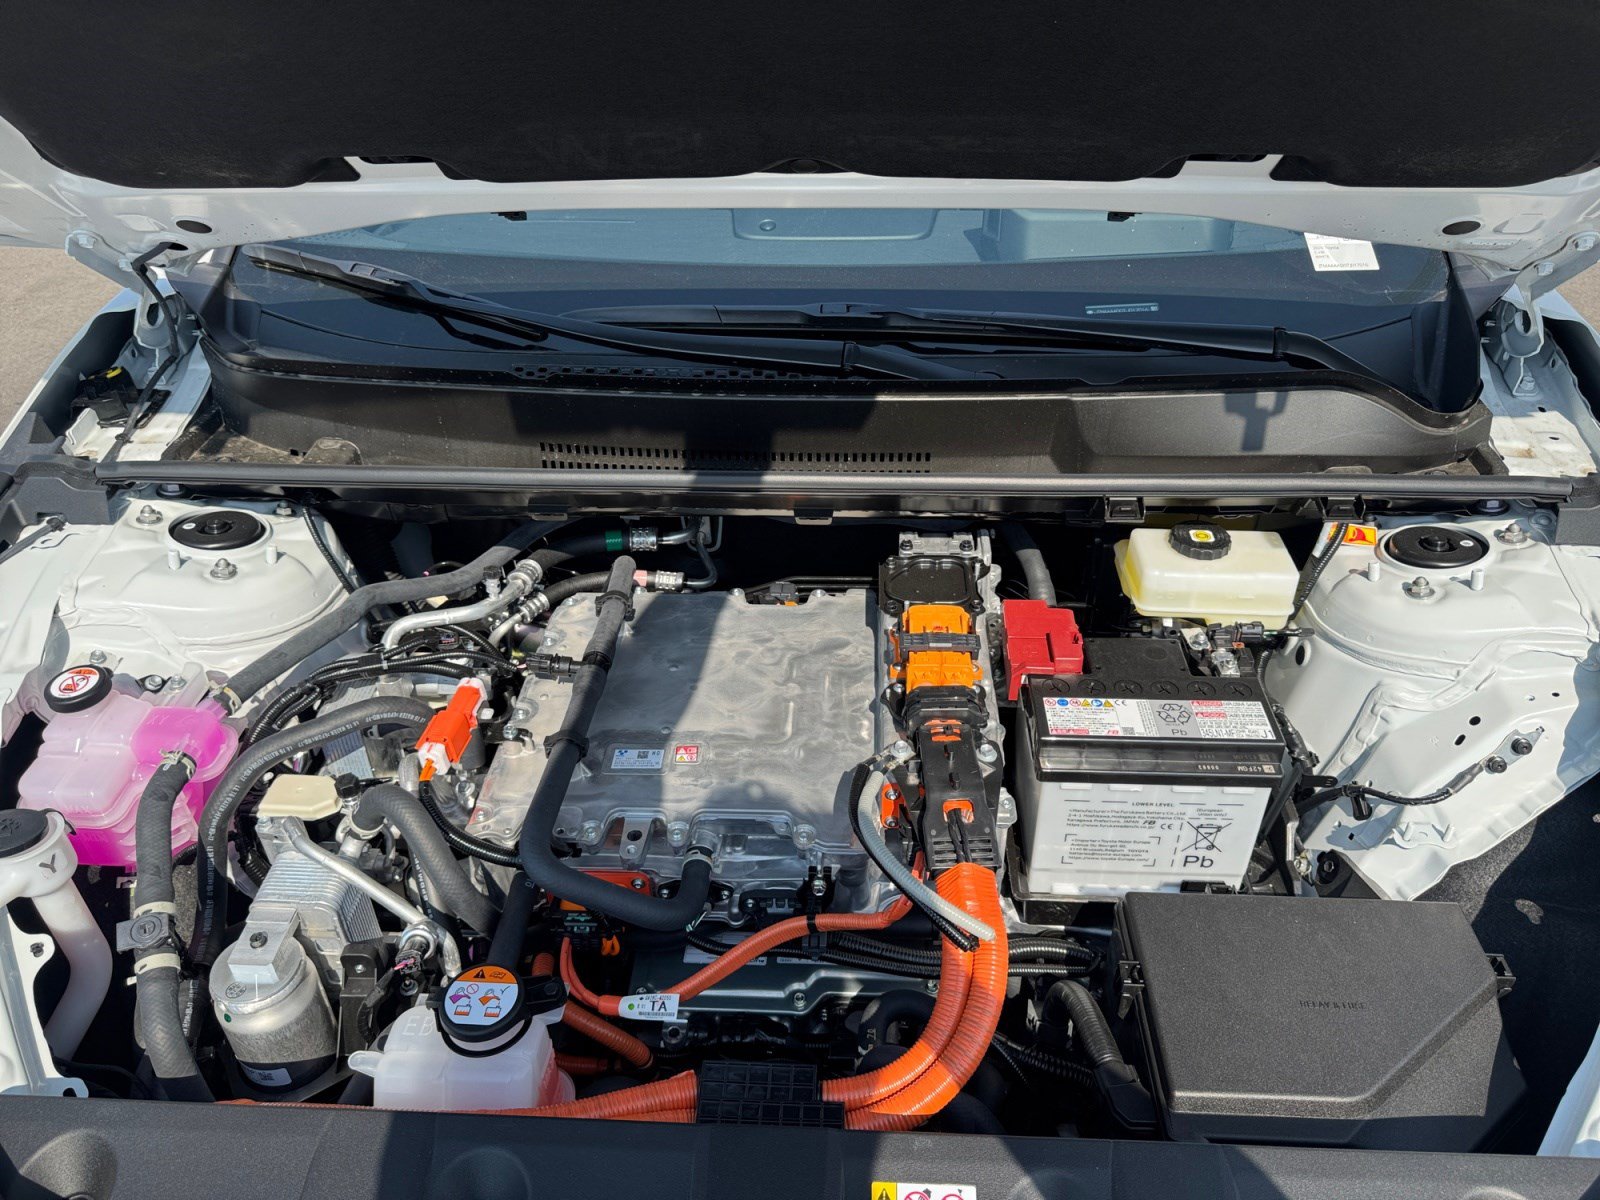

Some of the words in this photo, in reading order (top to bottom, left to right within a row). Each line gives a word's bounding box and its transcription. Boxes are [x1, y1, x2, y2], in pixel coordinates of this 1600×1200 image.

[1183, 855, 1214, 868] Pb
[650, 1000, 667, 1012] TA
[402, 1015, 434, 1036] EB
